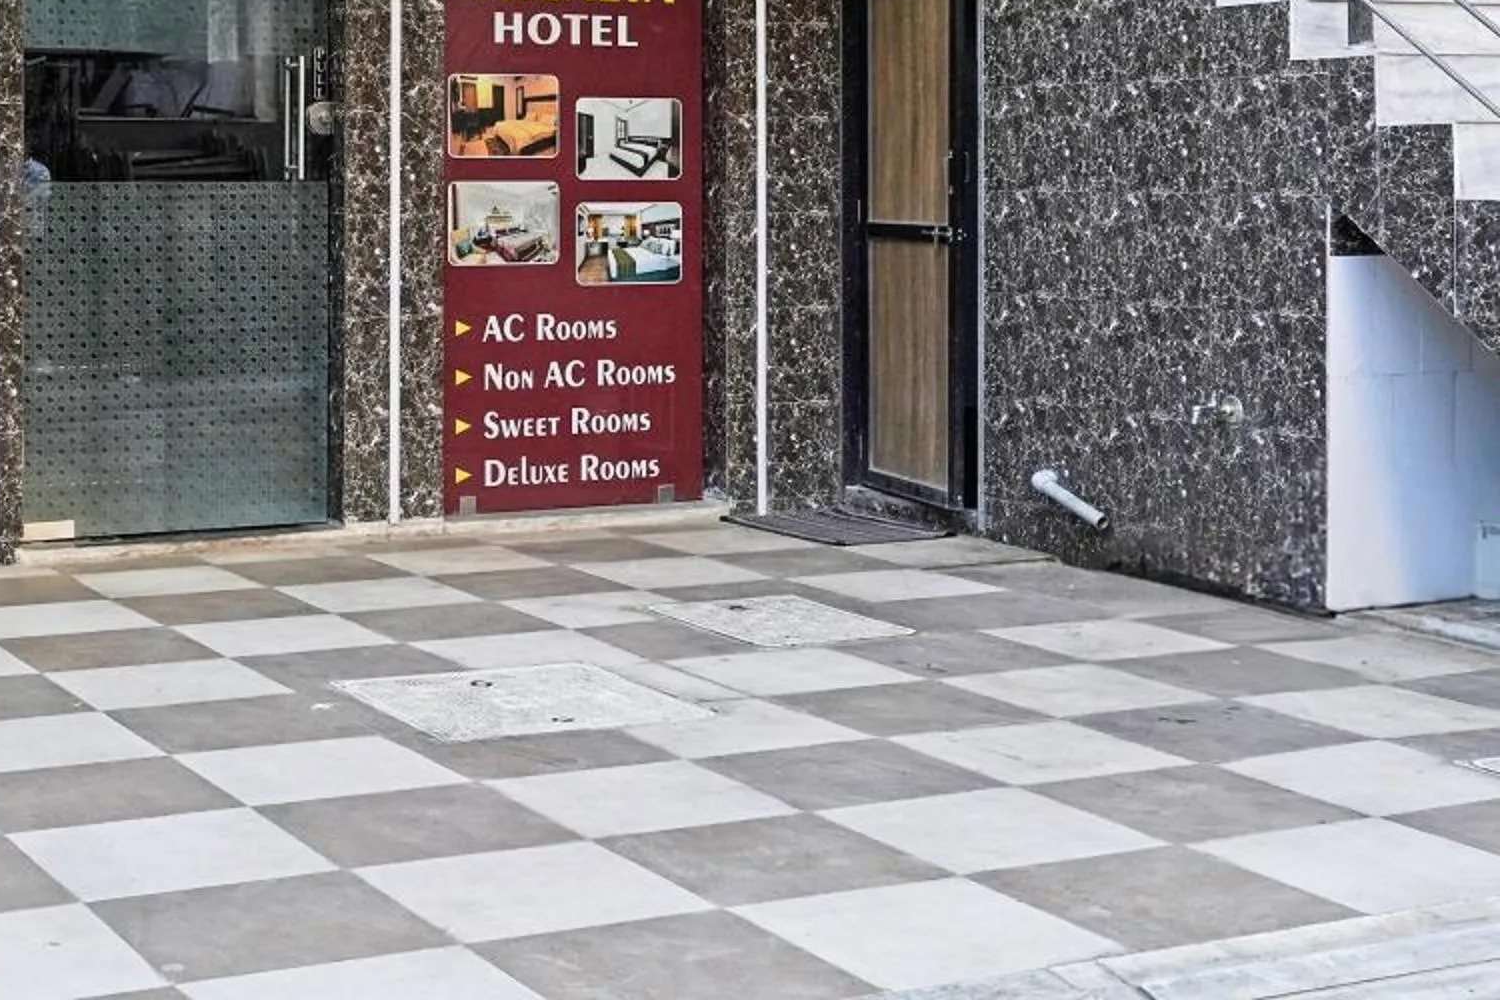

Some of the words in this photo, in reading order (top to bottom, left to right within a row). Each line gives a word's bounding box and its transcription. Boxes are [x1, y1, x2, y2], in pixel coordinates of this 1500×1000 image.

[492, 11, 639, 48] HOTEL
[482, 313, 525, 342] AC
[543, 359, 586, 388] AC
